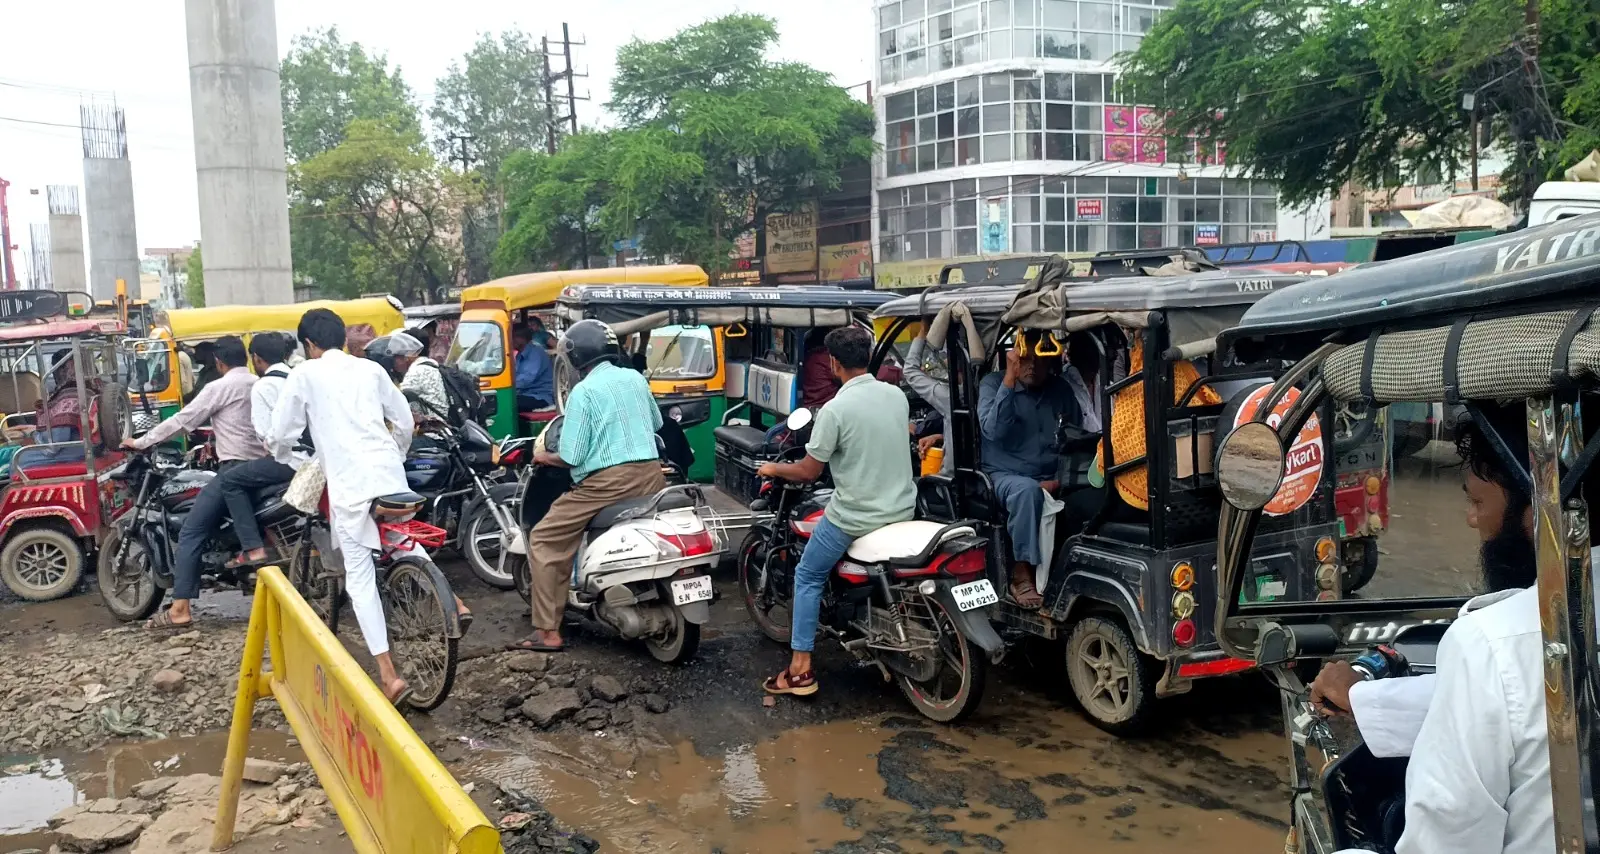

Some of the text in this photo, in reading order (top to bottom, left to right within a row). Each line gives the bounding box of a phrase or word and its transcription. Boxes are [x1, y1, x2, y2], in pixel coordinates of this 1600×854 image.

[1493, 225, 1600, 274] YATR
[1235, 279, 1273, 292] YATRI
[960, 584, 985, 597] MP 04
[976, 594, 996, 606] 6215
